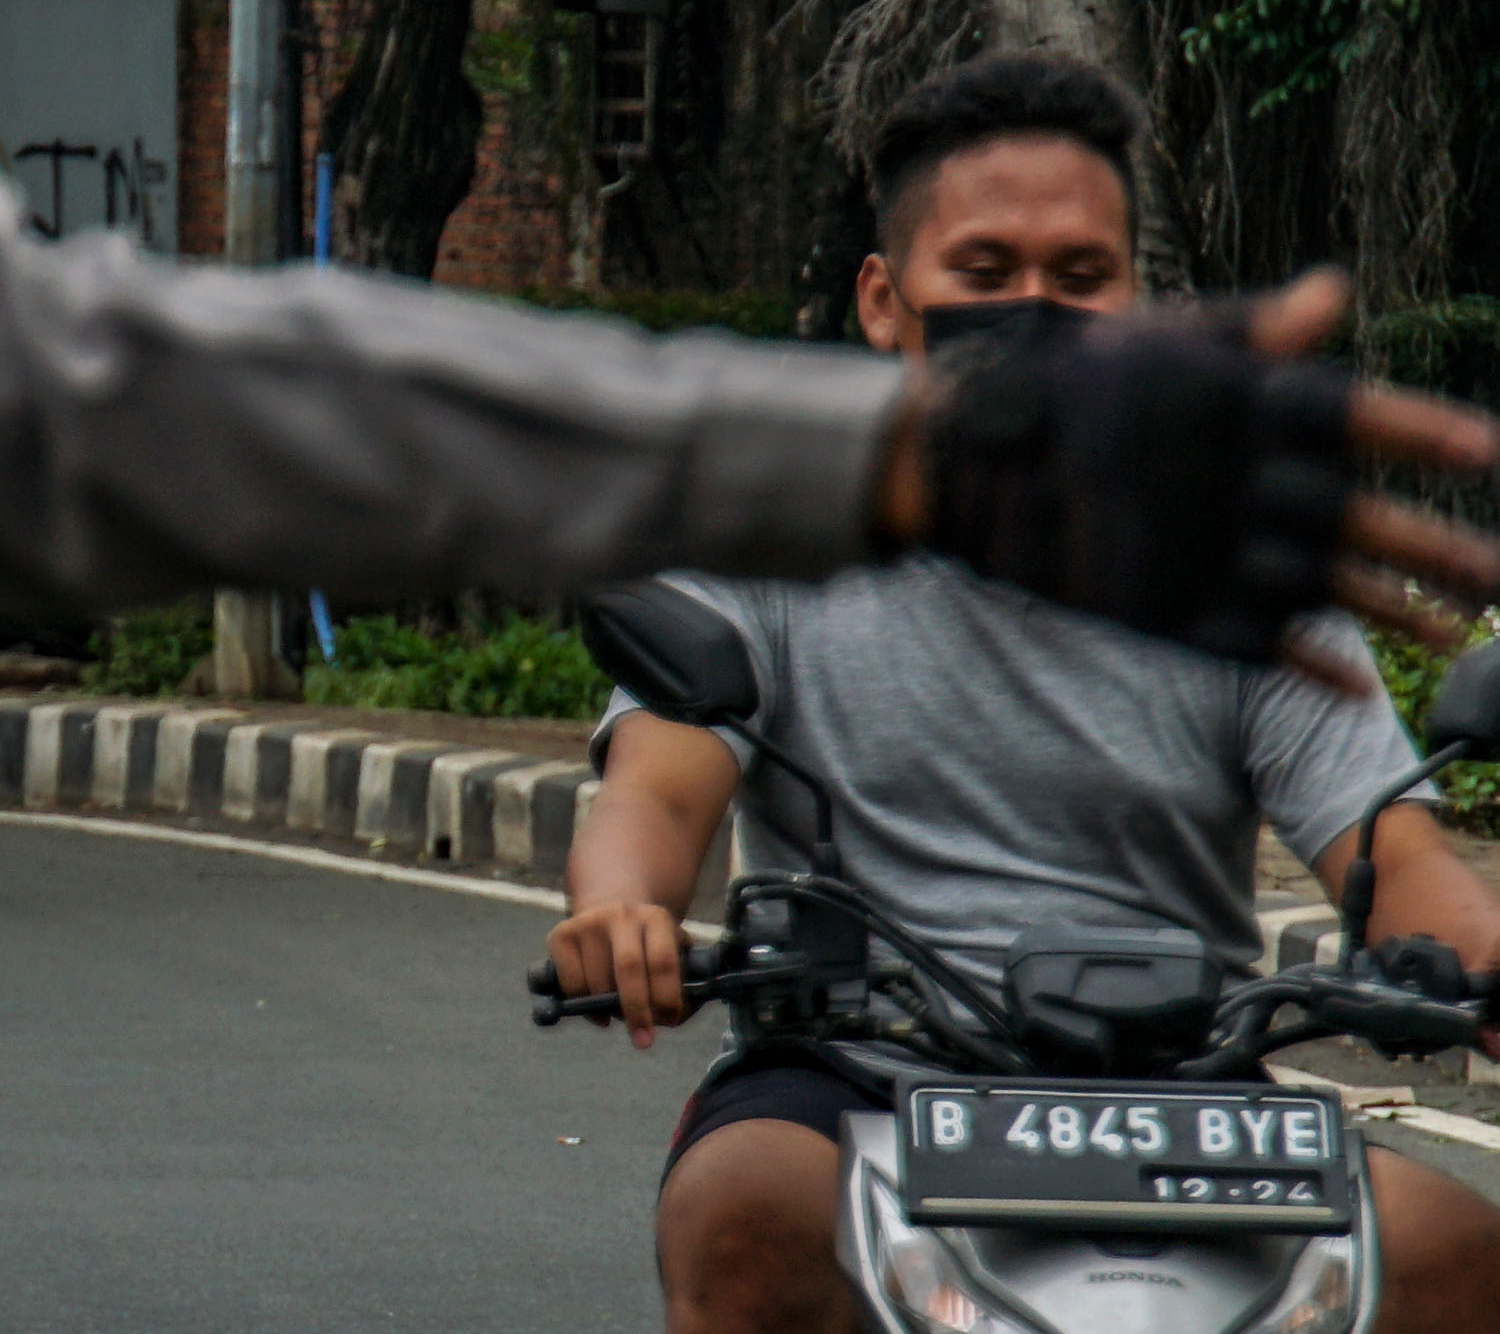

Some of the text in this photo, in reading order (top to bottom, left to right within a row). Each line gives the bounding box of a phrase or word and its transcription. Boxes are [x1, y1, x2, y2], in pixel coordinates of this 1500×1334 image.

[931, 1099, 1319, 1157] B 4845 BYE
[1088, 1270, 1185, 1288] HONDA
